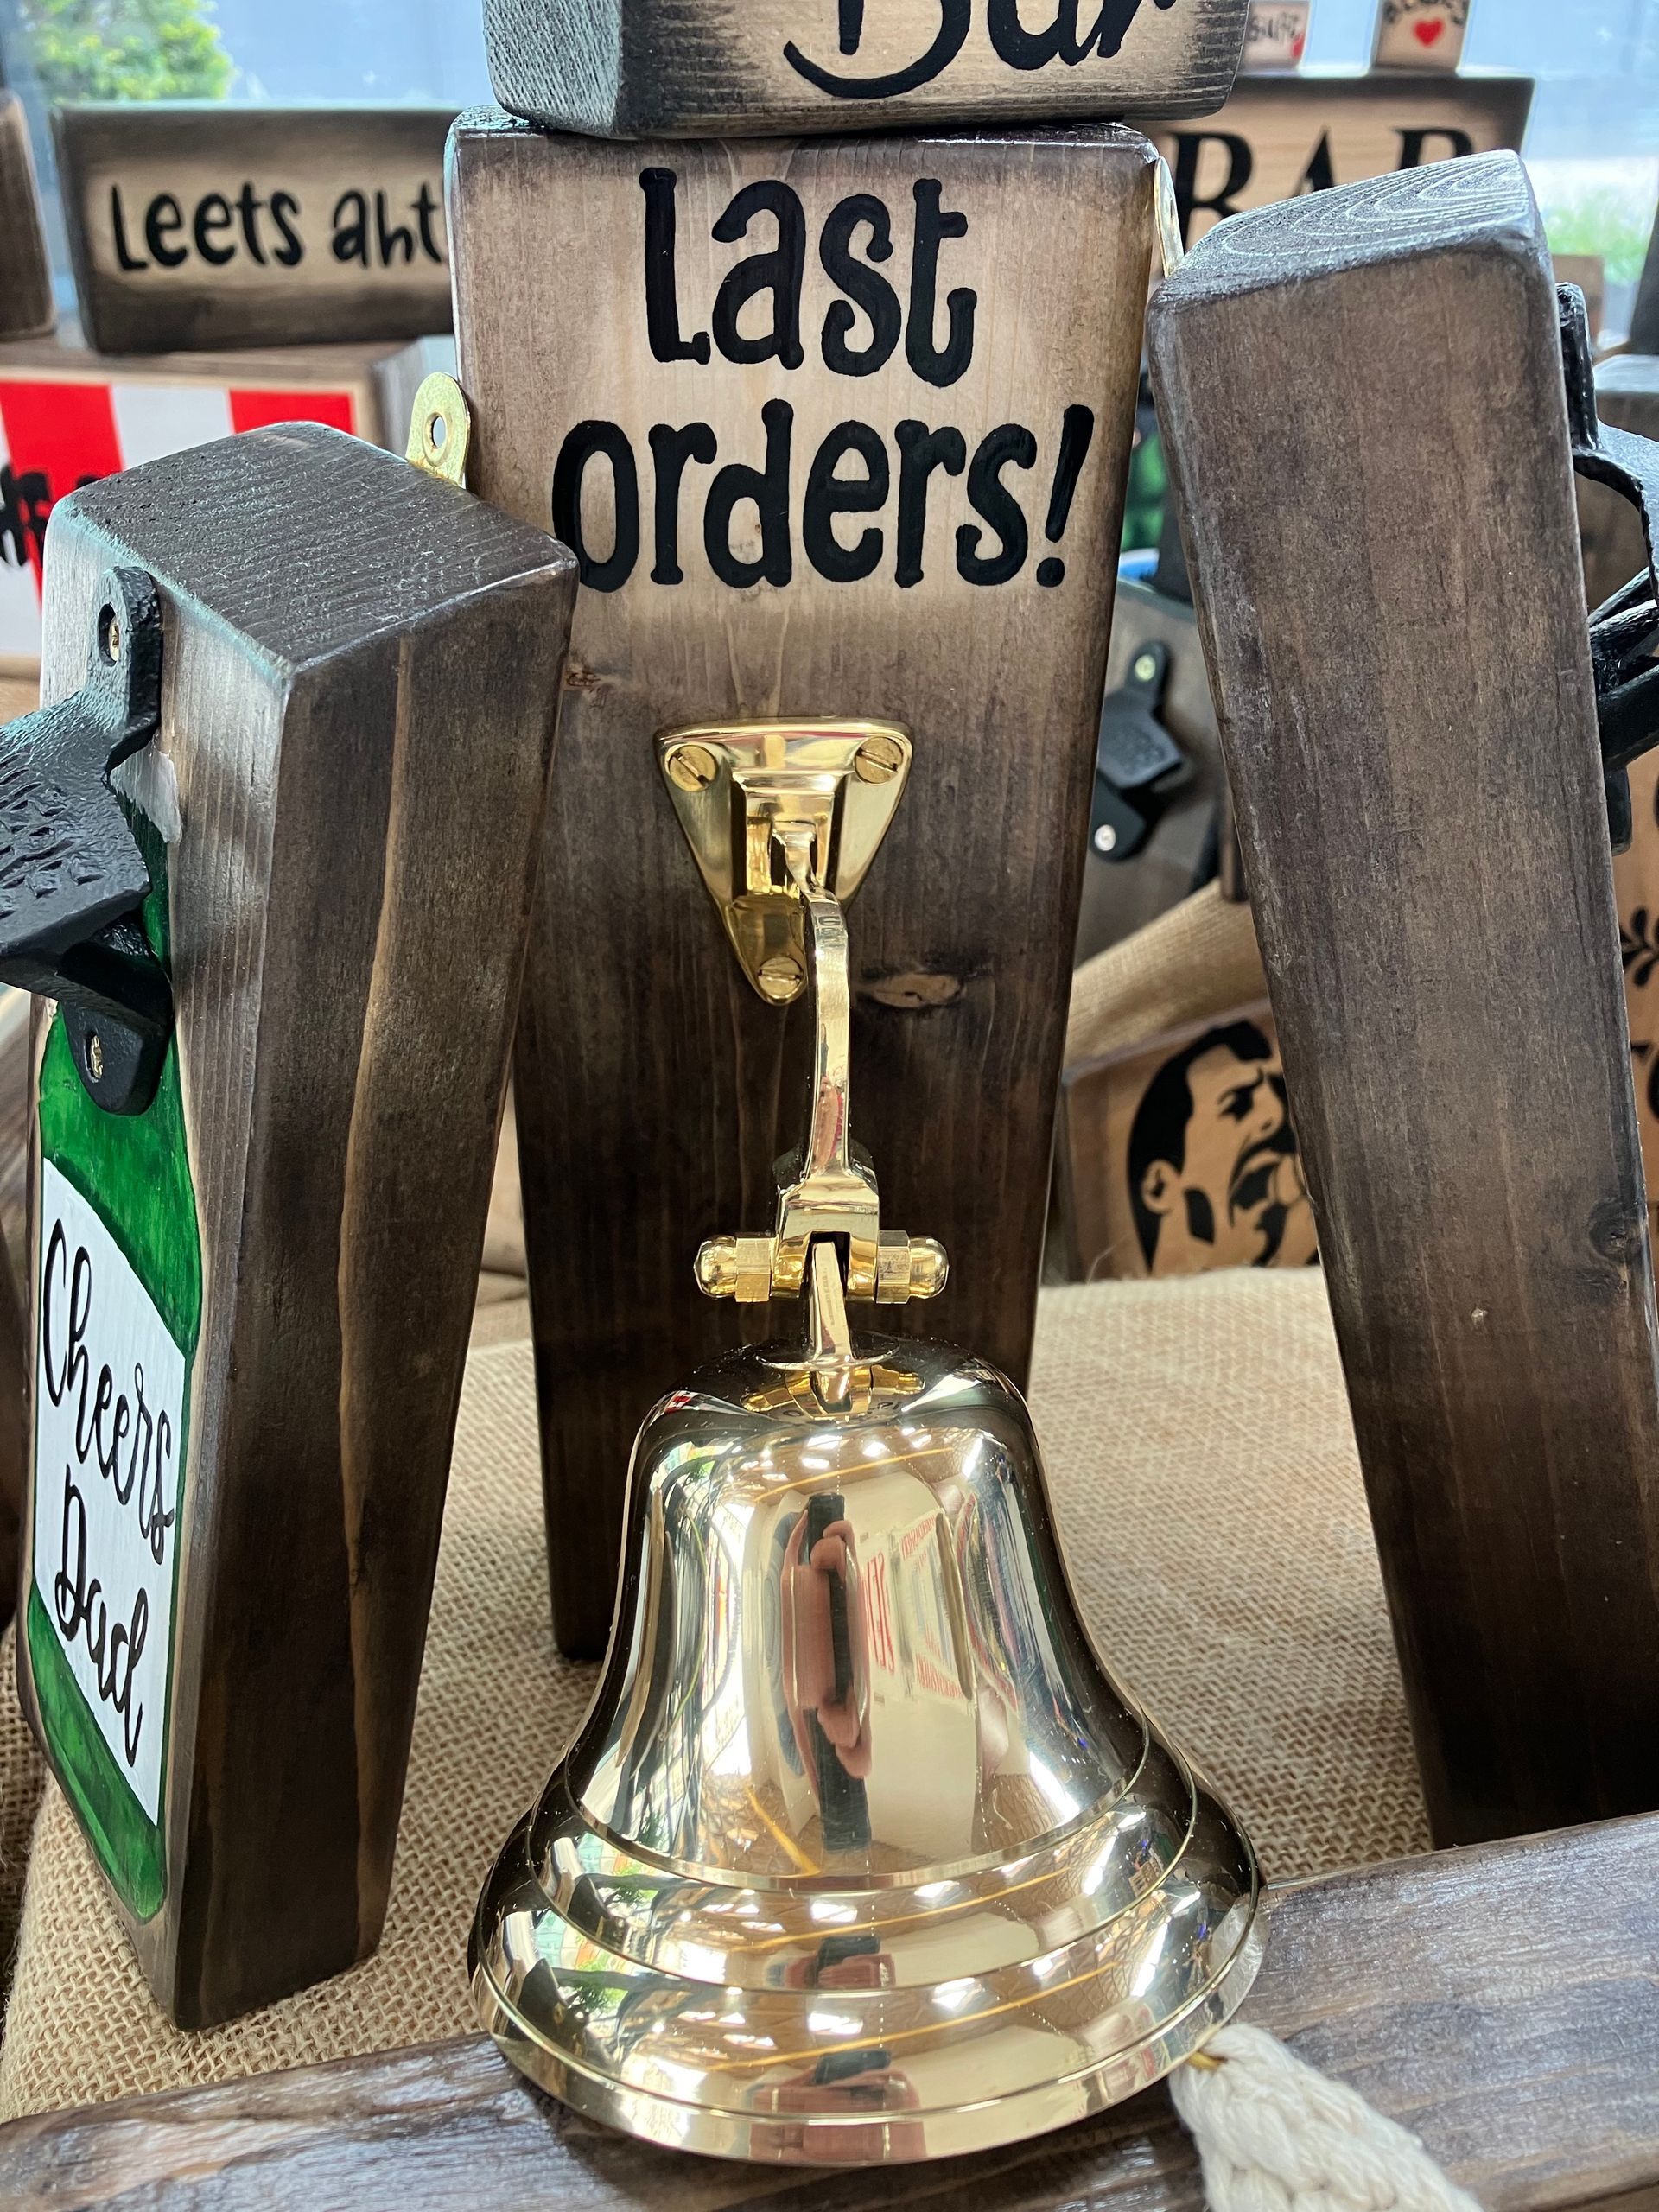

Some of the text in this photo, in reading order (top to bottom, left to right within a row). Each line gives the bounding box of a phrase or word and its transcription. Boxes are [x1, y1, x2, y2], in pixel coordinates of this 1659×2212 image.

[110, 182, 304, 272] Leets
[551, 398, 1095, 594] orders!
[42, 1218, 175, 1566] Cheers
[54, 1464, 149, 1768] Dad
